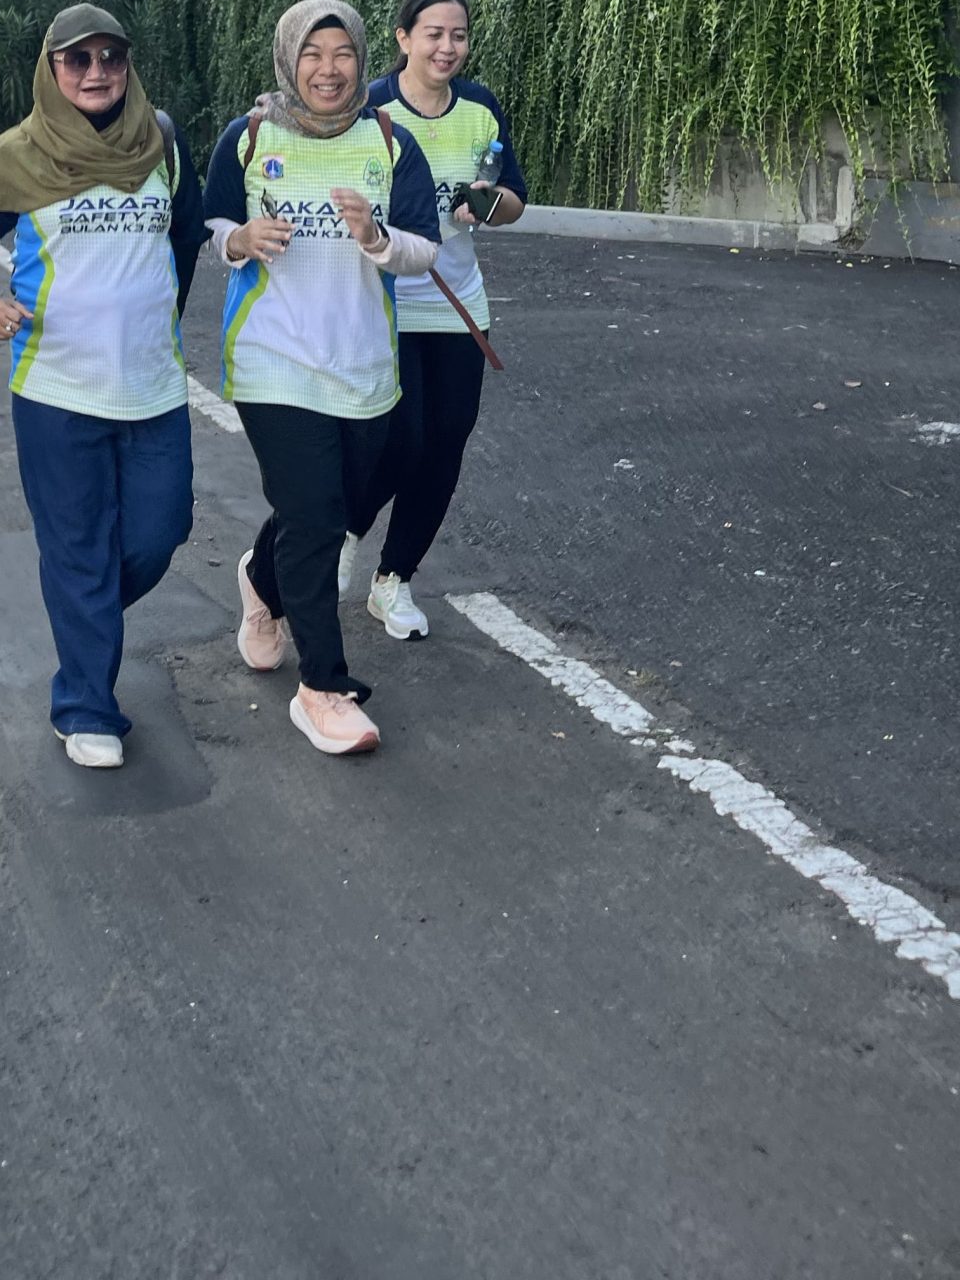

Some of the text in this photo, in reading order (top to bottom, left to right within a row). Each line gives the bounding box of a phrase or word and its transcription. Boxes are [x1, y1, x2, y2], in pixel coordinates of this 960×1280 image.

[59, 212, 146, 224] SAFETY
[61, 223, 119, 234] BULAN
[124, 223, 144, 233] K3
[321, 229, 343, 239] K3
